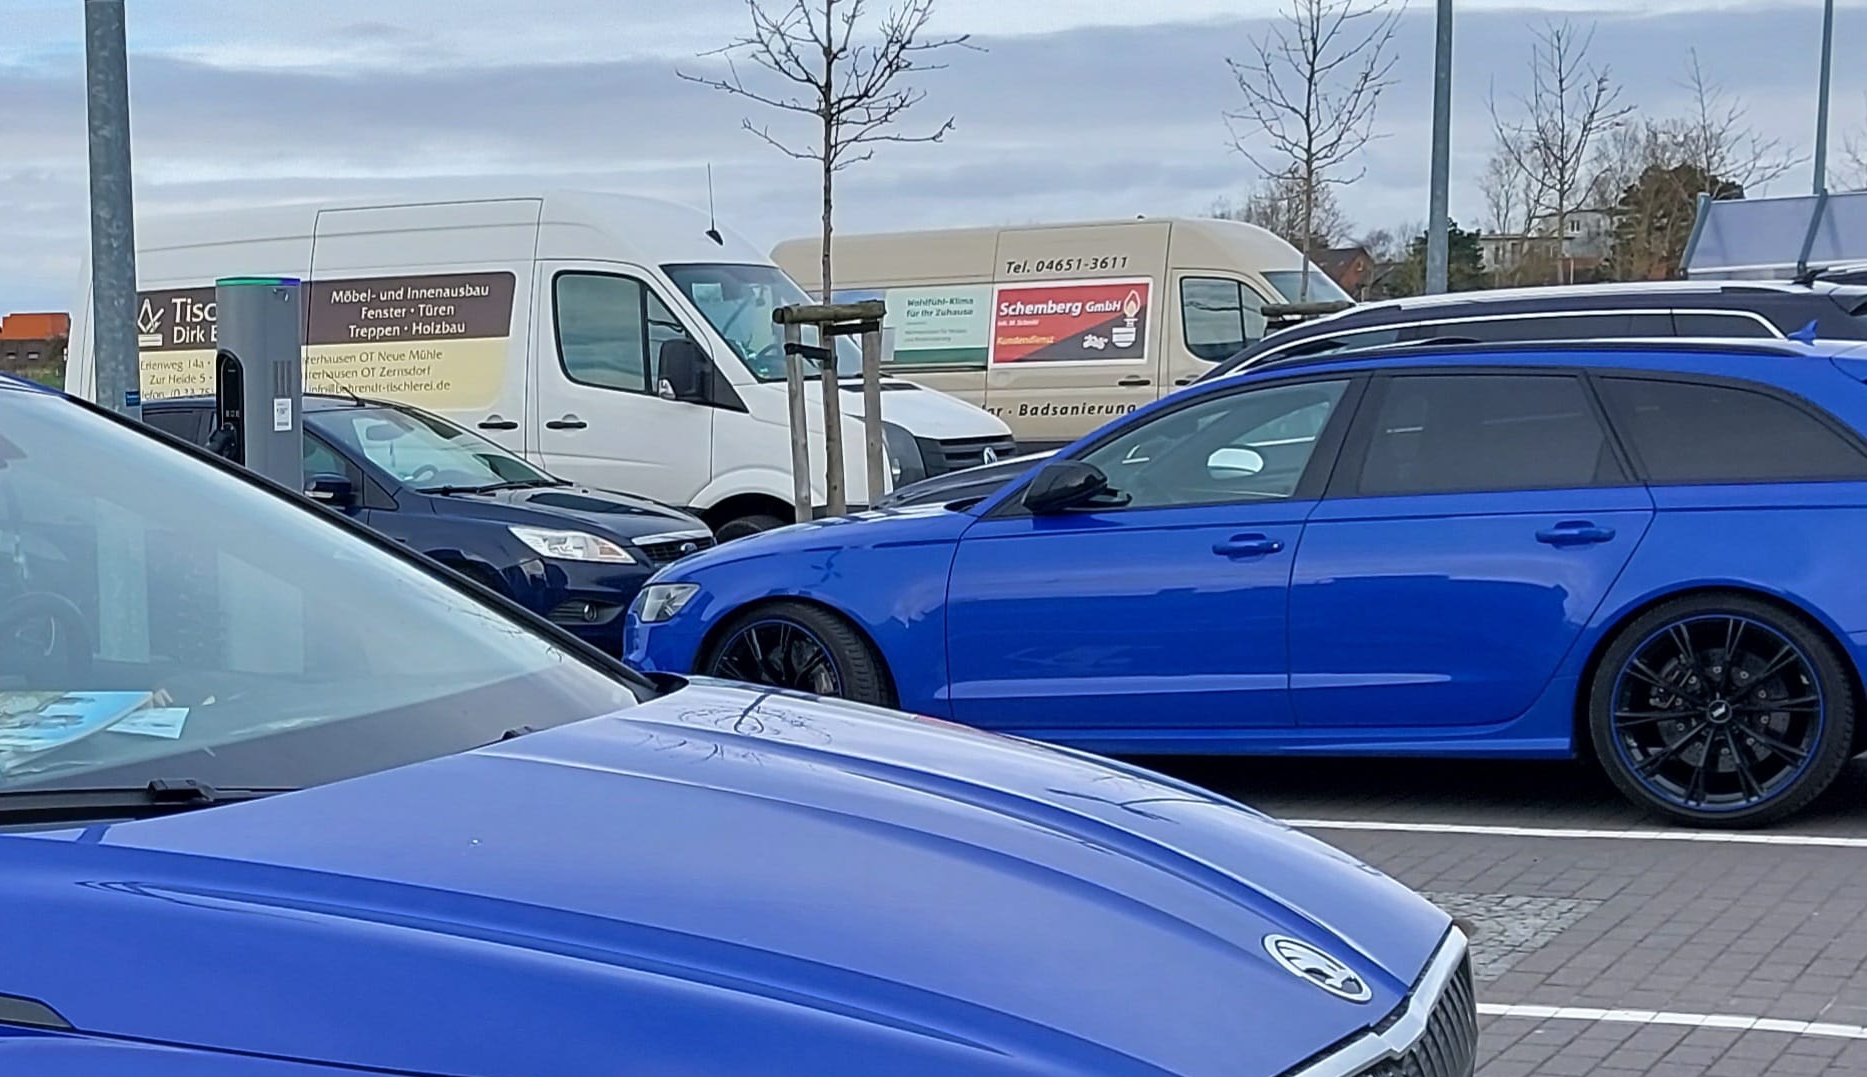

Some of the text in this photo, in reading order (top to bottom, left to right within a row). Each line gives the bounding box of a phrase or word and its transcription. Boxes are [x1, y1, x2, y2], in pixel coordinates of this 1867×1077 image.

[1006, 256, 1128, 274] Tel. 04651-3611
[330, 283, 490, 304] Möbel- und Innenausbau
[360, 303, 455, 320] Fenster Türen
[999, 300, 1122, 317] Schemberg GmbH
[173, 325, 206, 344] Dirk
[348, 320, 466, 340] Treppen Holzbau
[359, 351, 374, 363] OT
[377, 350, 406, 362] Neue
[408, 348, 443, 361] Mühle
[149, 374, 166, 386] Zur
[168, 373, 197, 385] Heide
[361, 366, 375, 378] OT
